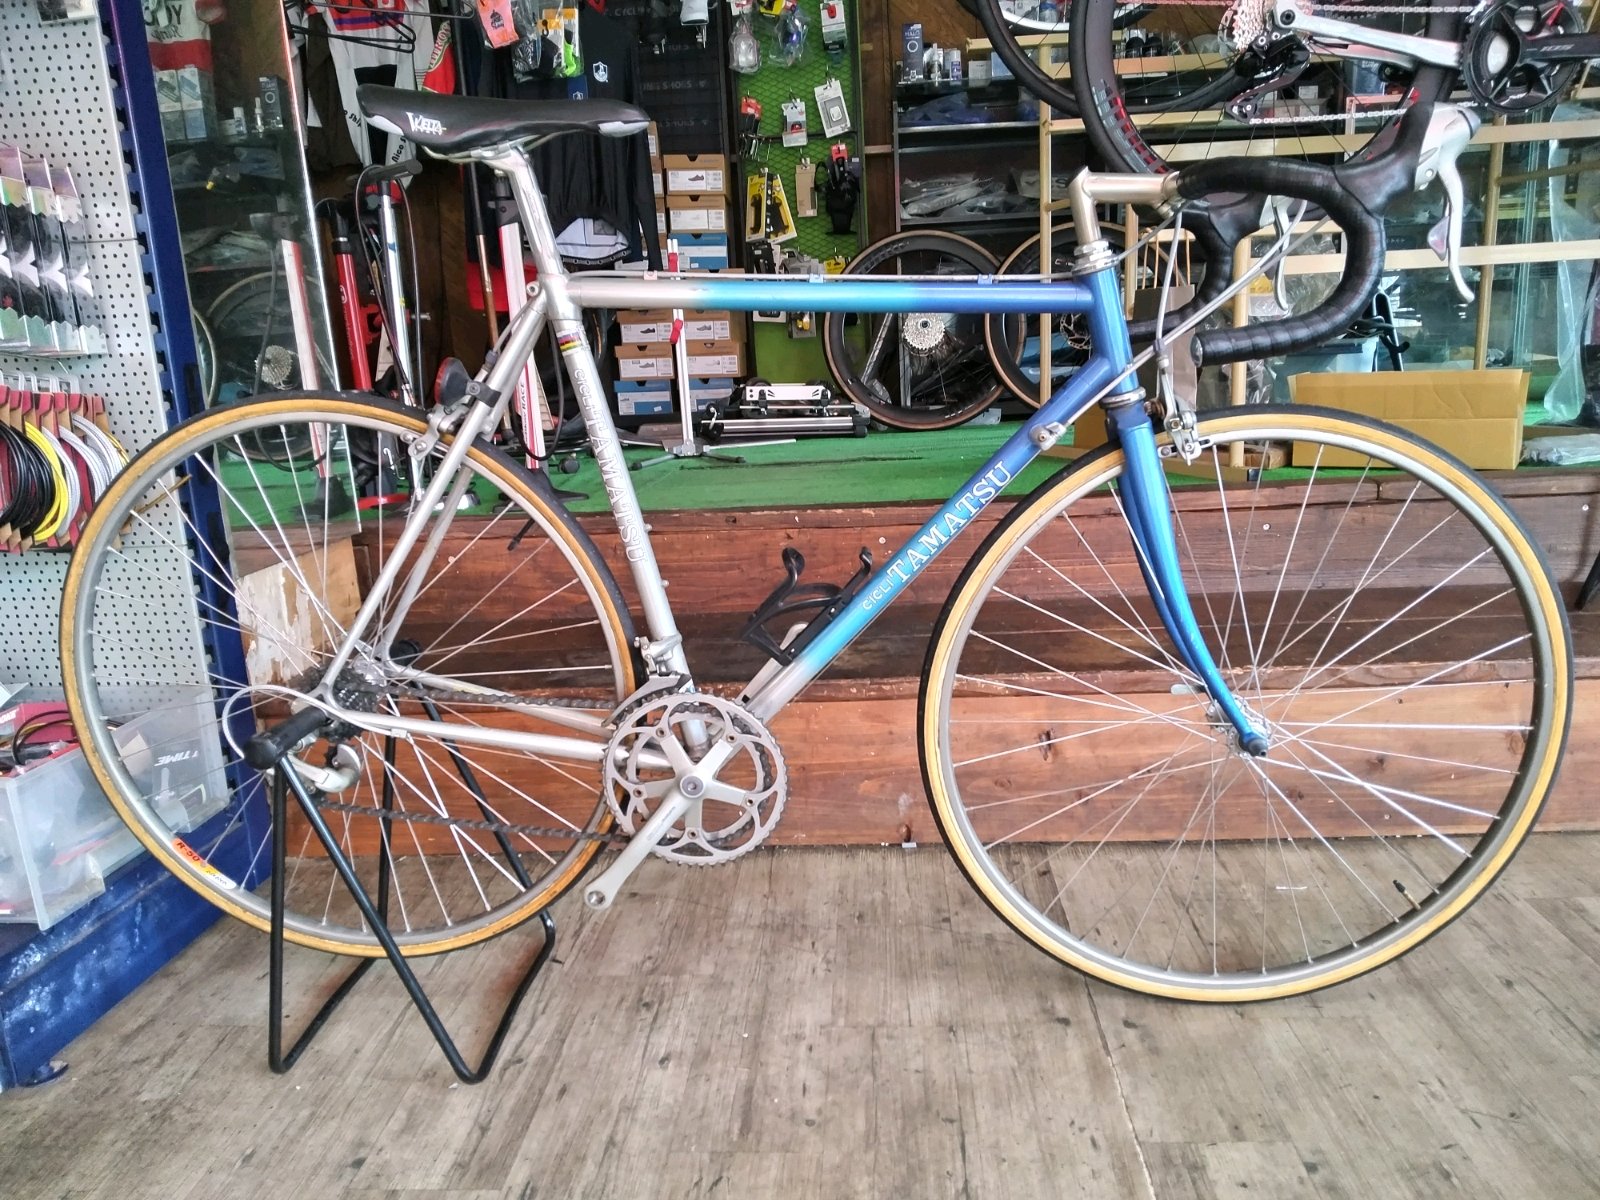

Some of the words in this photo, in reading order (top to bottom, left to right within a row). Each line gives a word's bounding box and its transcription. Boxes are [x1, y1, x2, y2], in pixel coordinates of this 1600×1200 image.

[585, 409, 648, 563] TAMATSU
[863, 580, 893, 610] CICLI
[888, 462, 1011, 582] TAMATSU
